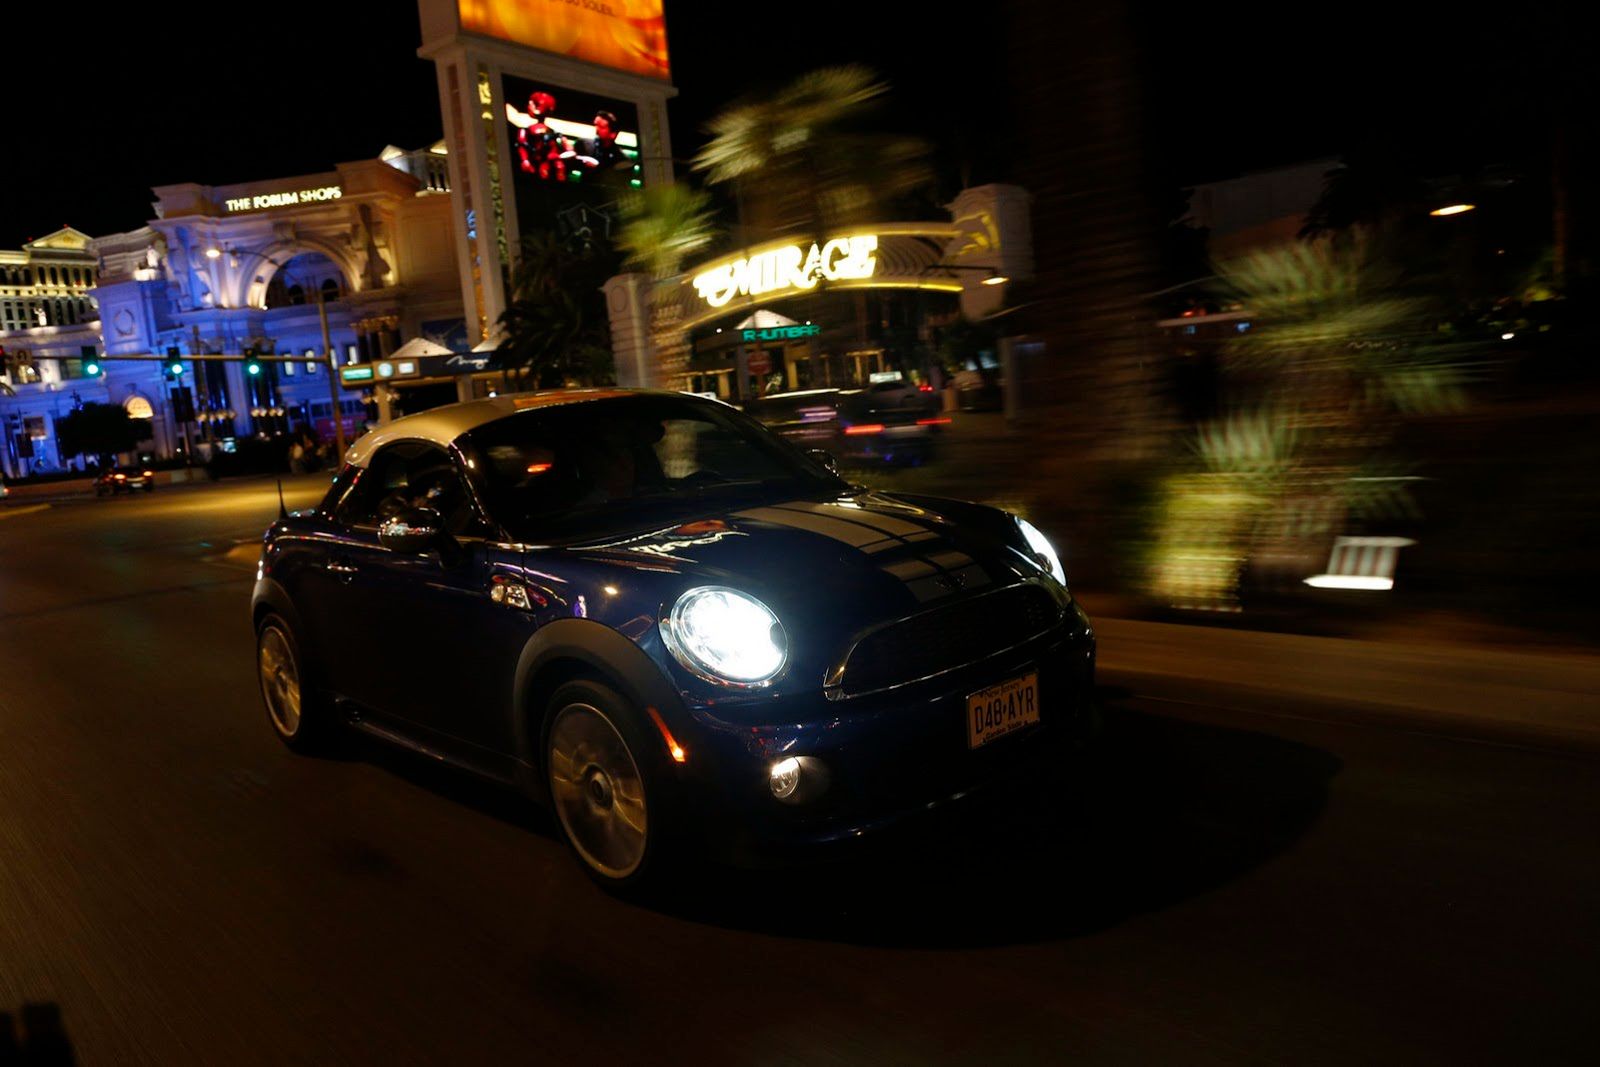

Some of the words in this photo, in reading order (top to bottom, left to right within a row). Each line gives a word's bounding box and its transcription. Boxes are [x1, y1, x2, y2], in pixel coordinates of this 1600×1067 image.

[225, 198, 251, 211] THE
[253, 192, 298, 208] FORUM
[299, 186, 342, 202] SHOPS
[707, 235, 878, 307] MIRAGE
